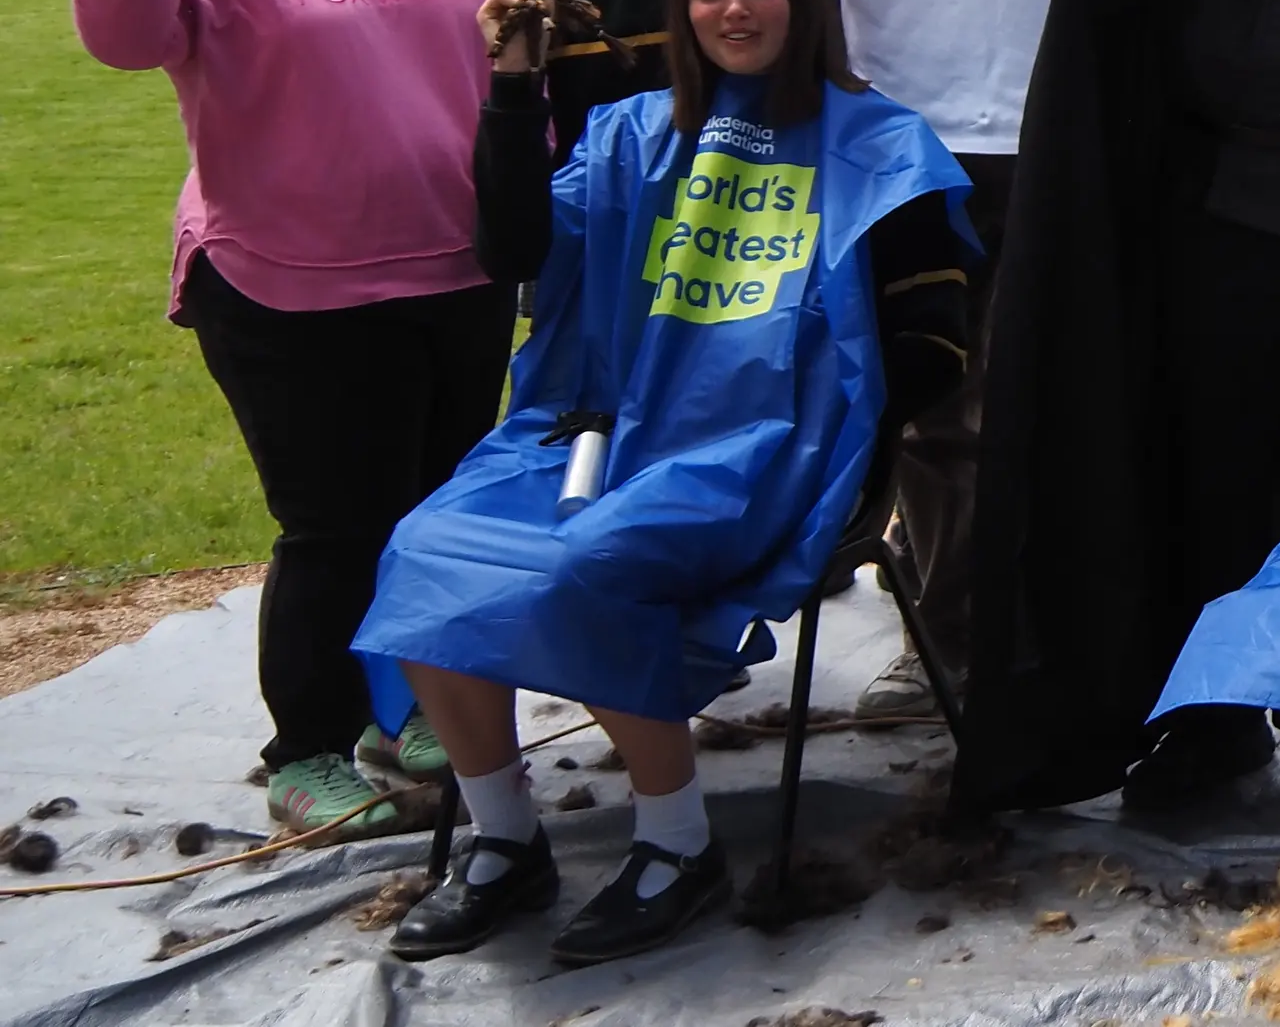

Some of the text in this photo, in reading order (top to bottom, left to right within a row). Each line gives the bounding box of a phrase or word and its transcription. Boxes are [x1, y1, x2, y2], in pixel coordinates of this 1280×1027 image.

[698, 128, 776, 155] undation
[702, 114, 774, 141] ukaemia
[686, 174, 797, 213] orld's
[660, 221, 805, 264] eatest
[655, 268, 765, 308] have
